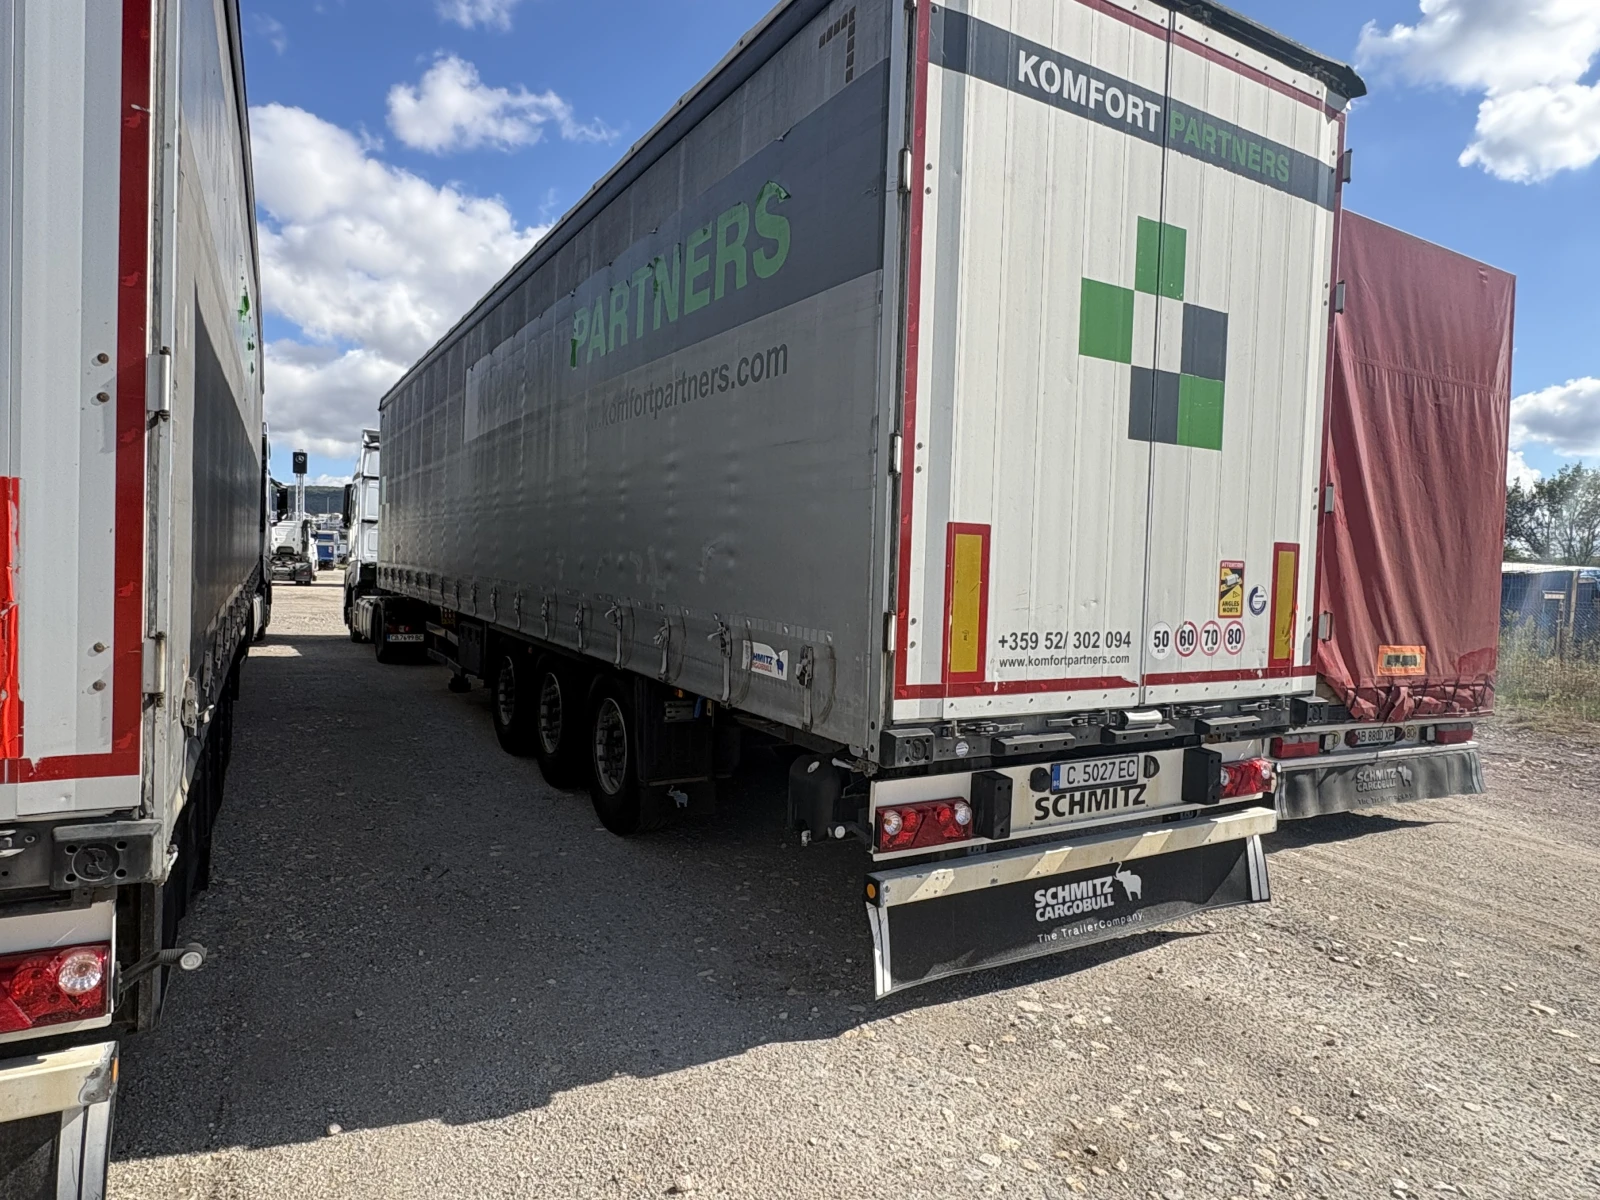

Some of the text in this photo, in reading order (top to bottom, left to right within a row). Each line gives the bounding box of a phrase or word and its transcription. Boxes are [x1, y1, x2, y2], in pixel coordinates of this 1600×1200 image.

[1018, 49, 1290, 183] KOMFORT PARTNERS
[570, 180, 791, 371] PARTNERS
[585, 343, 788, 430] .komfortpartners.com
[998, 630, 1132, 650] +359 52/ 302 094
[1154, 630, 1169, 648] 50
[1180, 630, 1194, 647] 60
[1204, 629, 1218, 646] 70
[1227, 628, 1241, 645] 80
[753, 653, 774, 664] HMITZ
[999, 654, 1130, 669] www.komfortpartners.com
[1357, 768, 1397, 793] SCHMITZ
[1035, 783, 1147, 821] SCHMITZ
[1034, 875, 1114, 908] SCHMITZ
[1035, 893, 1115, 922] CARGOBULL
[1037, 933, 1058, 944] The
